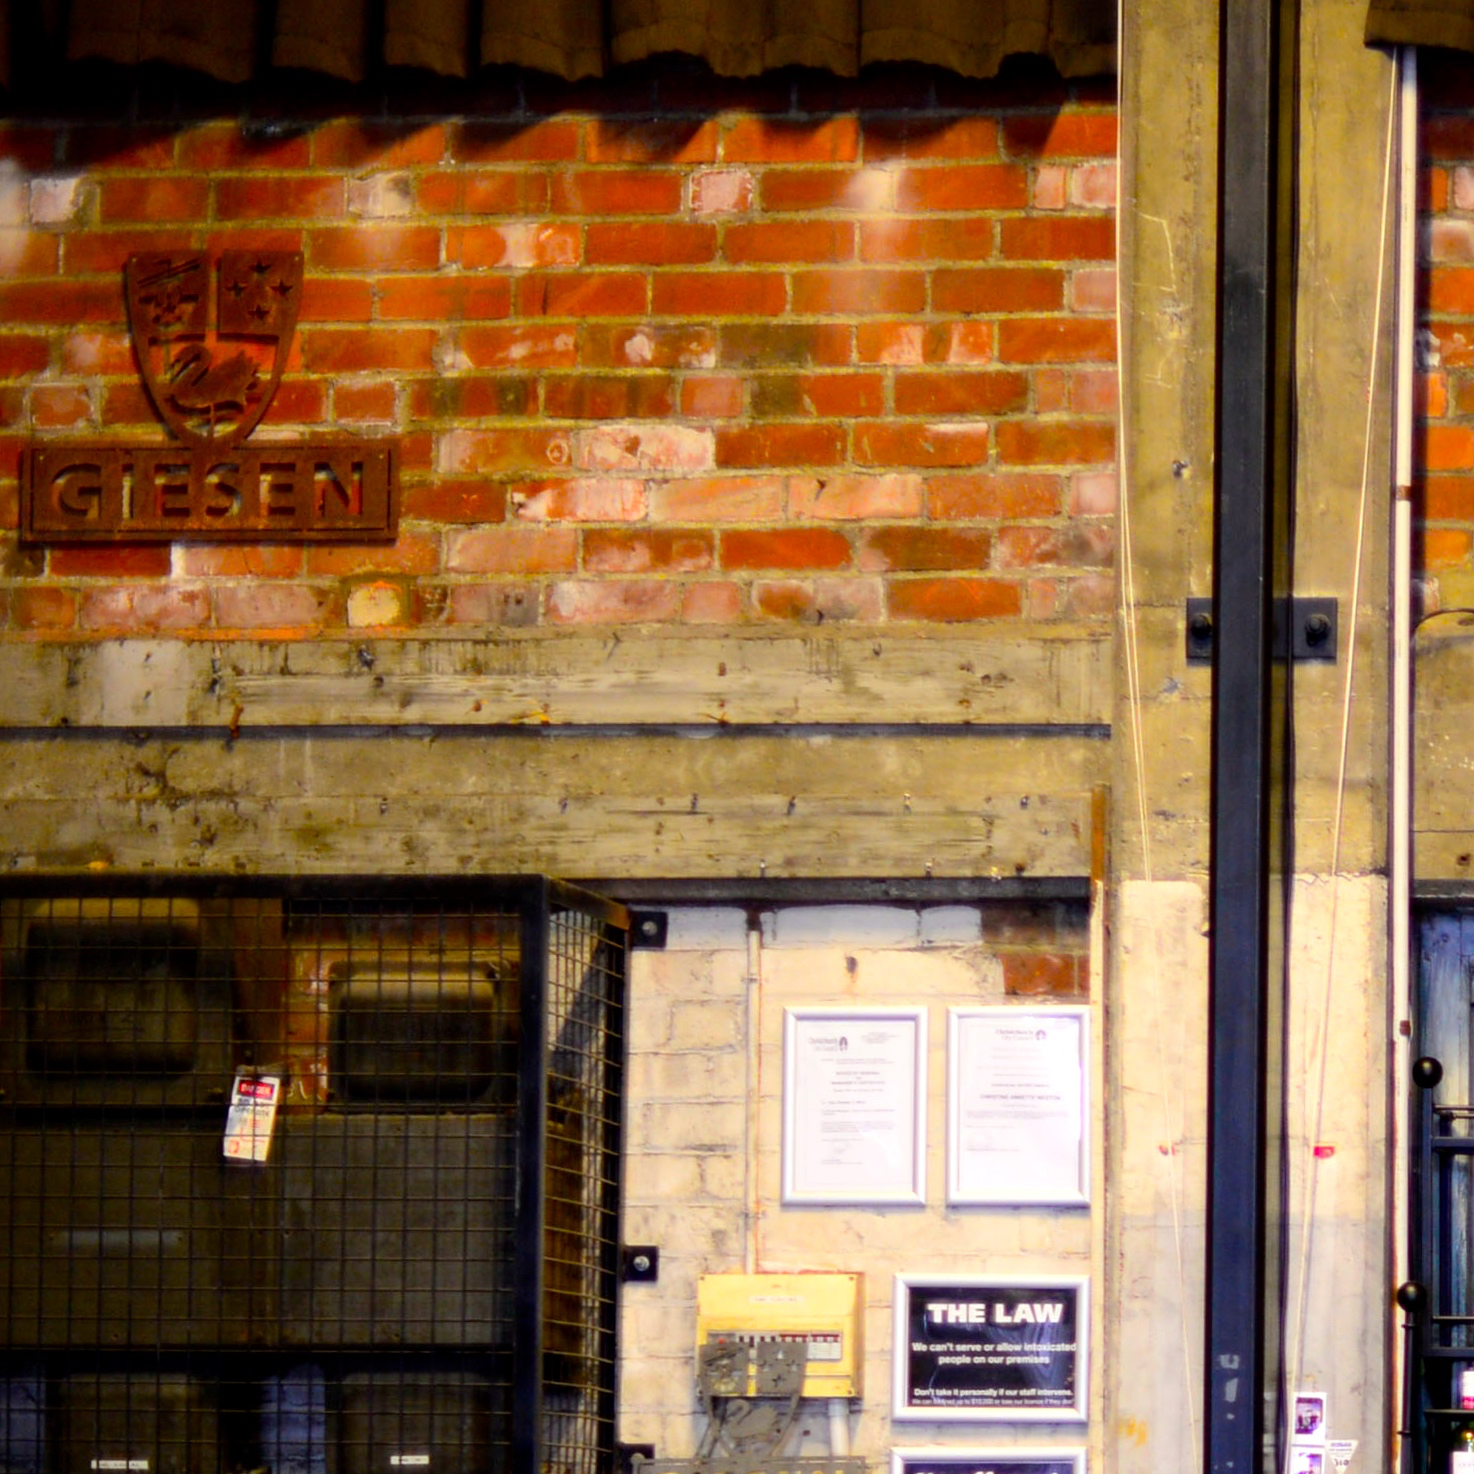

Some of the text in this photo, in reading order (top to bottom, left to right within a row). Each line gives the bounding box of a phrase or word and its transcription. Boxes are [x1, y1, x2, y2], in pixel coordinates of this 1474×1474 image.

[50, 461, 364, 519] GIESEN
[926, 1303, 1064, 1323] THE LAW
[912, 1342, 928, 1351] We
[929, 1342, 954, 1351] can't
[996, 1342, 1022, 1351] allow
[1024, 1342, 1077, 1351] intoxicated
[938, 1355, 1050, 1365] people on our premises
